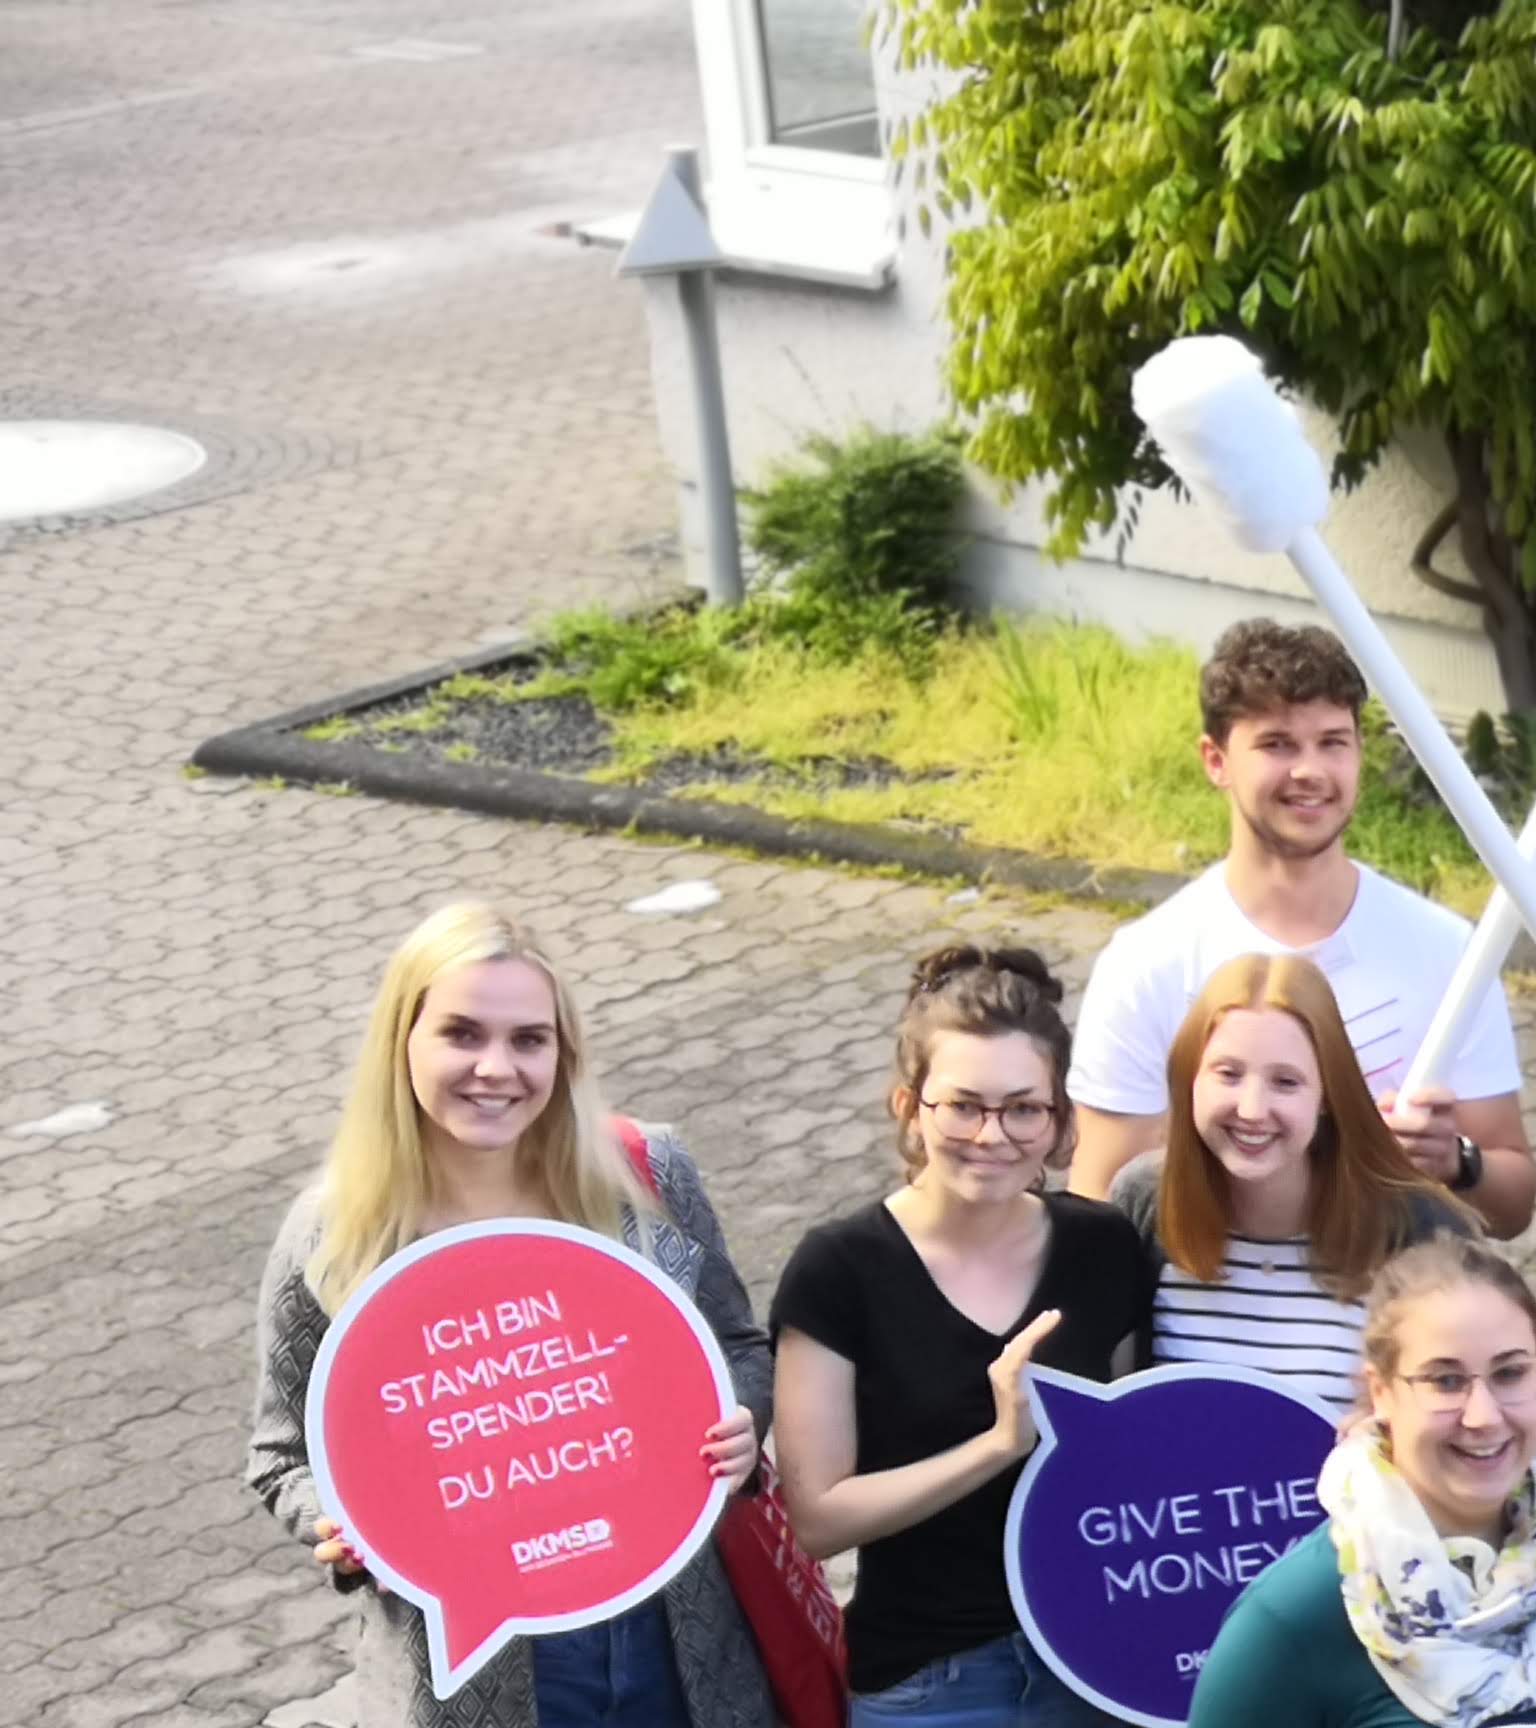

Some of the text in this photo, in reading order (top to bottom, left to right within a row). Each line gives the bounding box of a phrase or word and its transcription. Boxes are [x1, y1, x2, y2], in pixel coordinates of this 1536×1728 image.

[423, 1290, 561, 1355] ICH BIN
[380, 1331, 628, 1413] STAMMZELL-
[427, 1371, 613, 1450] SPENDER!
[438, 1427, 634, 1509] DU AUCH?
[511, 1525, 588, 1565] DKMS
[1078, 1477, 1319, 1546] GIVE THE
